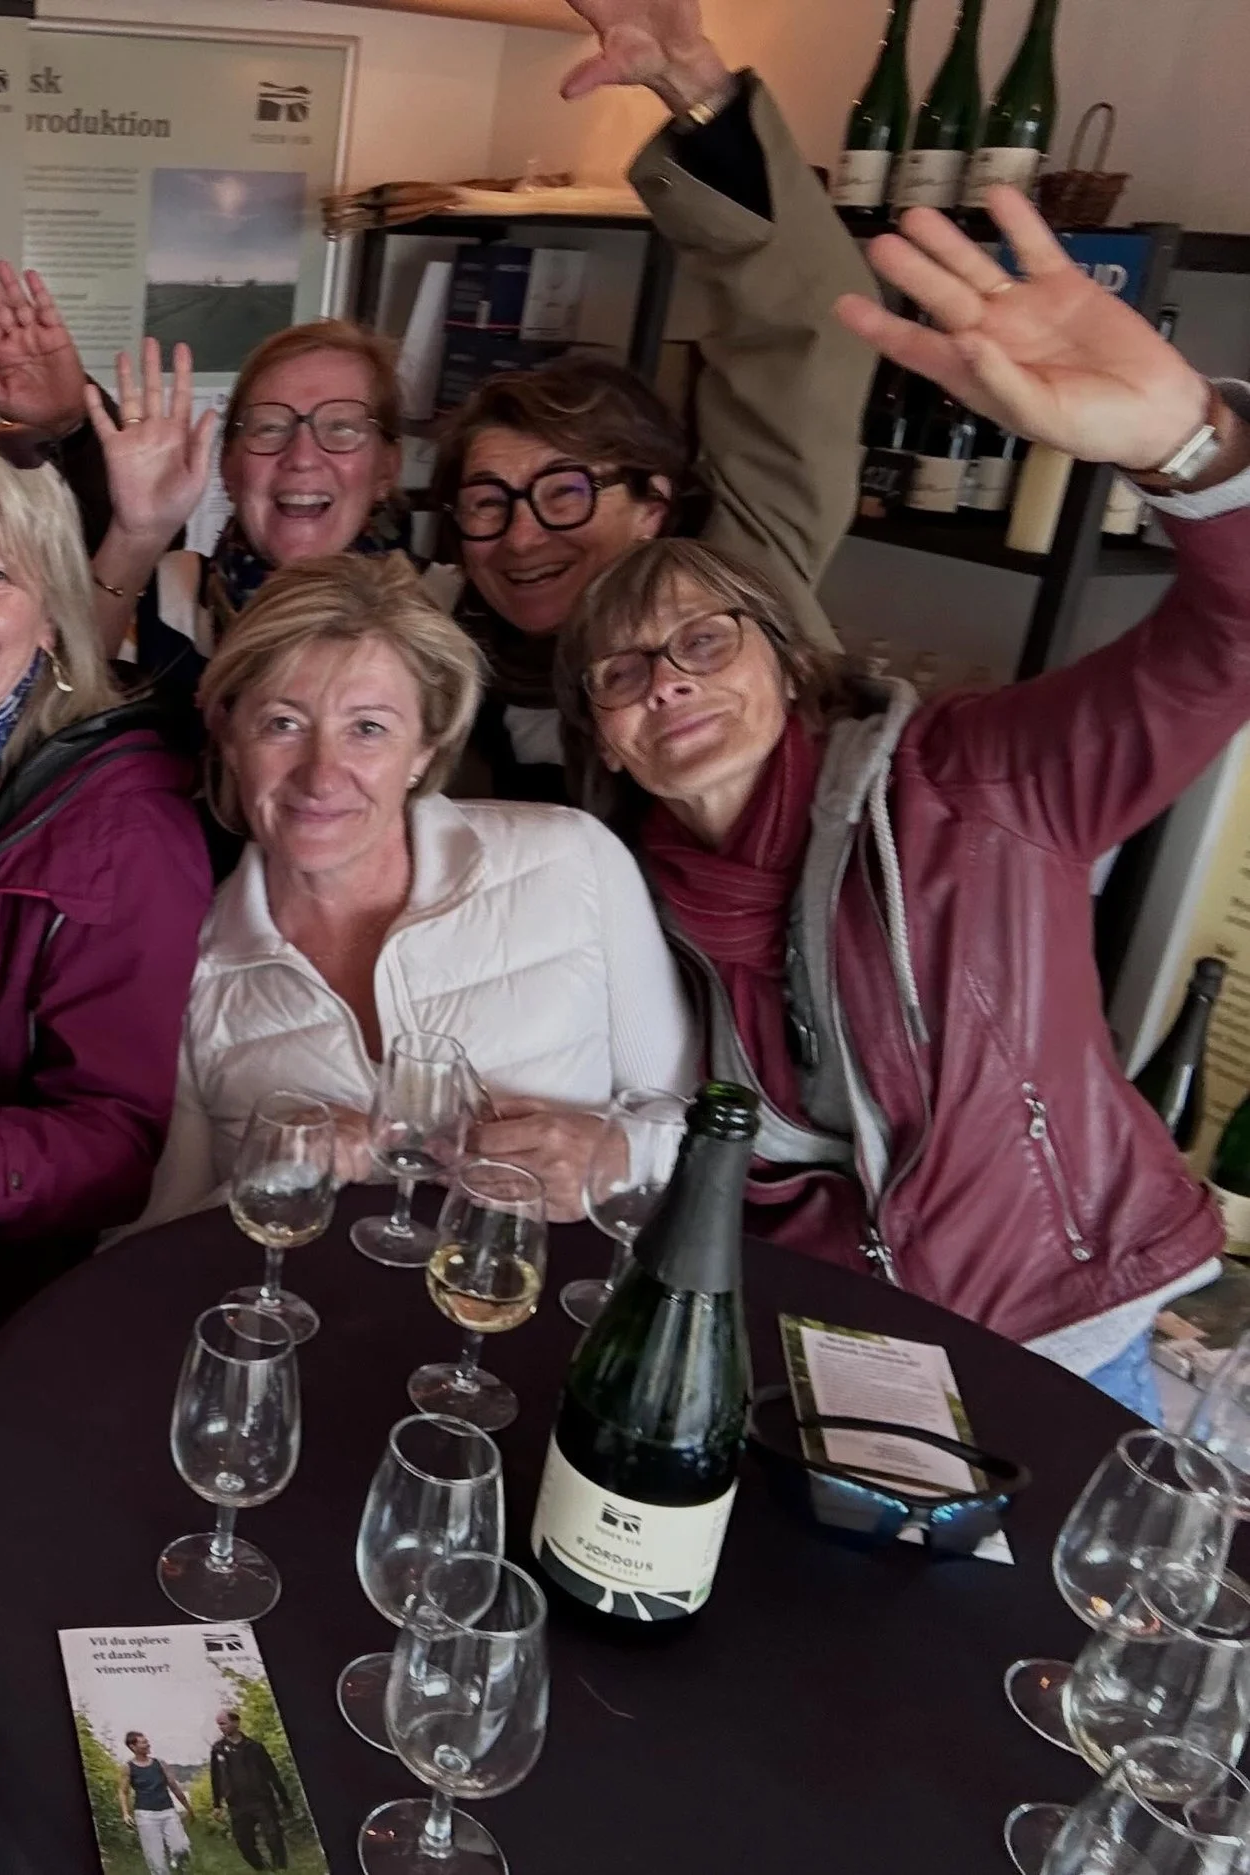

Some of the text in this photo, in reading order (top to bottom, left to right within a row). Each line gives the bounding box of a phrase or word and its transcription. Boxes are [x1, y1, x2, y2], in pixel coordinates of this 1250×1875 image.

[28, 67, 63, 94] sk
[110, 1636, 127, 1646] du
[128, 1635, 171, 1647] opleve
[93, 1649, 148, 1660] et dansk
[95, 1663, 171, 1675] vineventyr?
